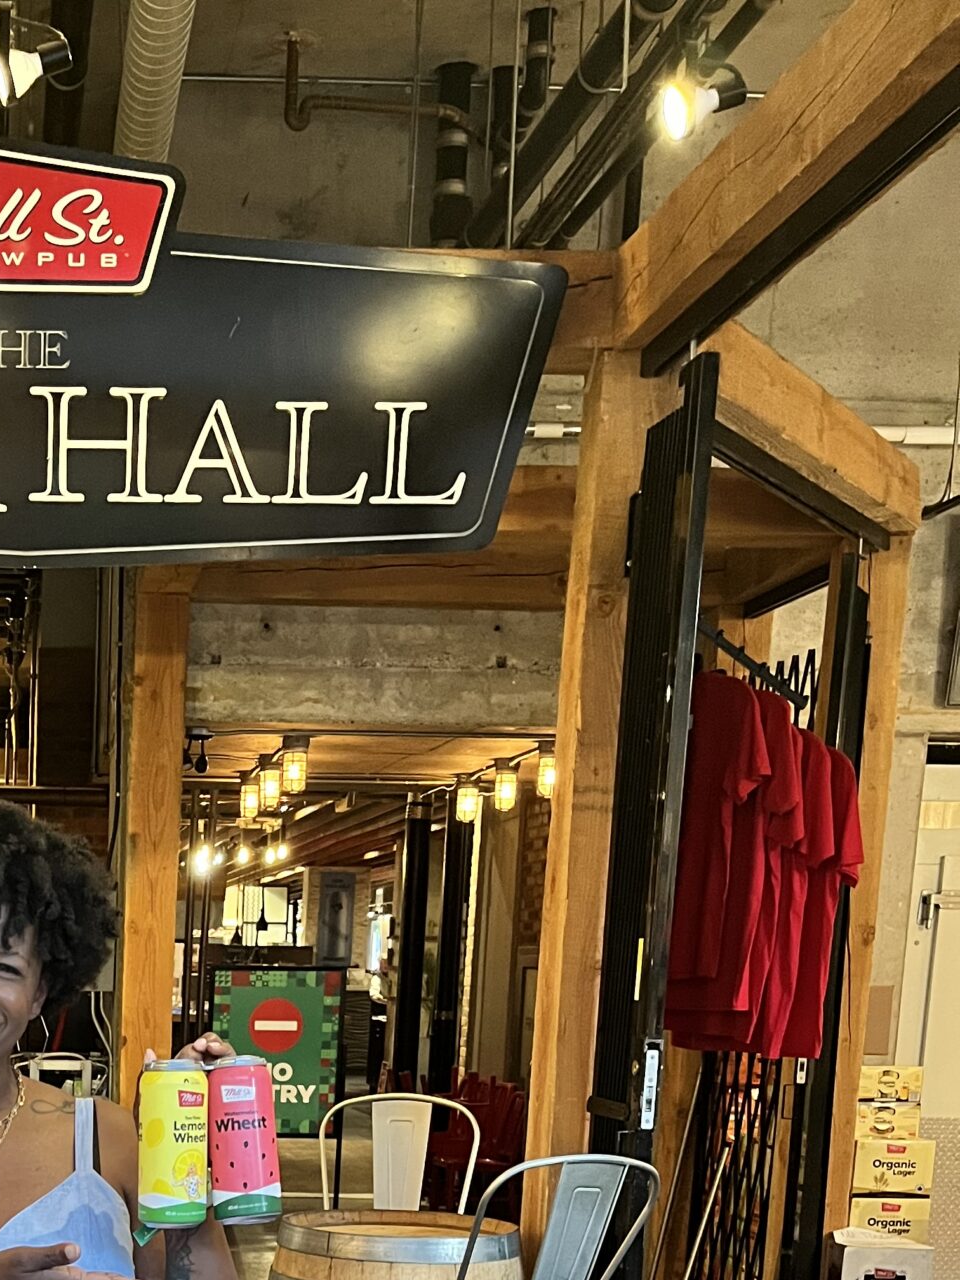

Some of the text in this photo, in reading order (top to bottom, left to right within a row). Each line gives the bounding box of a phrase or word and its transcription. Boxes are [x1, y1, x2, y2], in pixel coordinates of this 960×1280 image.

[44, 188, 125, 247] St.
[29, 385, 467, 507] HALL
[267, 1062, 293, 1082] O
[272, 1085, 317, 1103] TRY
[215, 1116, 267, 1133] Wheat
[873, 1159, 917, 1171] Organic
[892, 1169, 916, 1177] Lager
[867, 1217, 912, 1229] Organic
[887, 1227, 911, 1235] Lager
